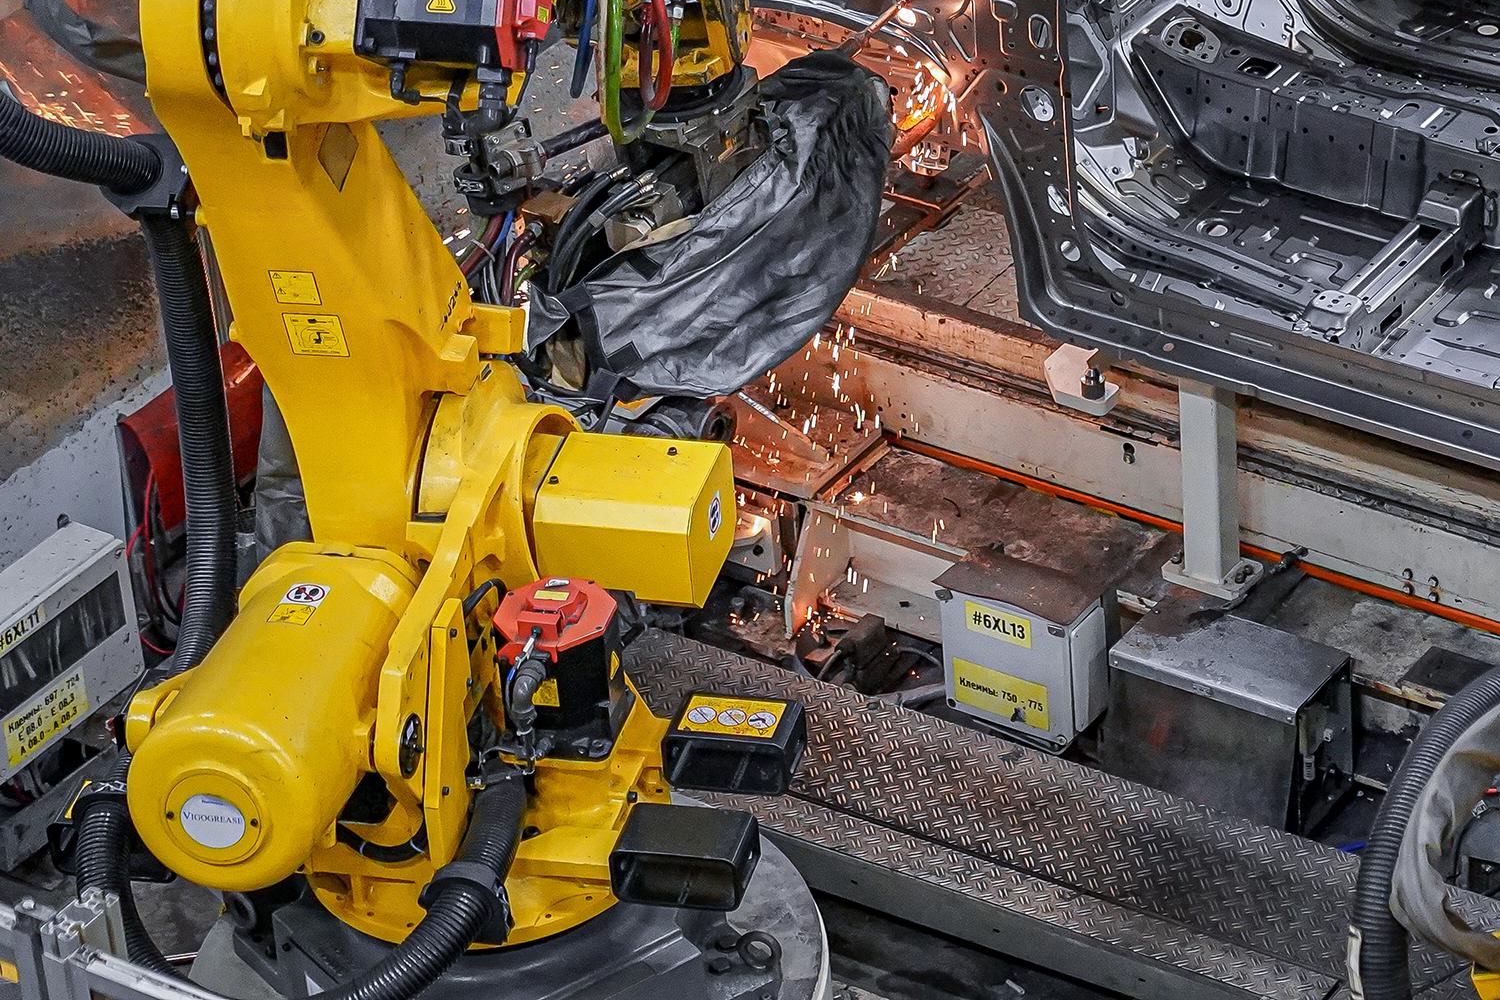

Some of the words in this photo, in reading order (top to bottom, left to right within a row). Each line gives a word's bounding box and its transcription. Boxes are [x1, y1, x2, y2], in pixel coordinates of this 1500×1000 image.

[973, 610, 1026, 639] #6XL13
[8, 702, 43, 734] Клеммы:
[44, 689, 58, 706] 697
[66, 673, 80, 689] 724
[58, 693, 75, 711] 08.3
[959, 676, 999, 698] Клеммы:
[1001, 690, 1018, 703] 750
[1028, 698, 1043, 712] 775
[28, 731, 45, 749] 08.0
[61, 706, 78, 724] 08.3
